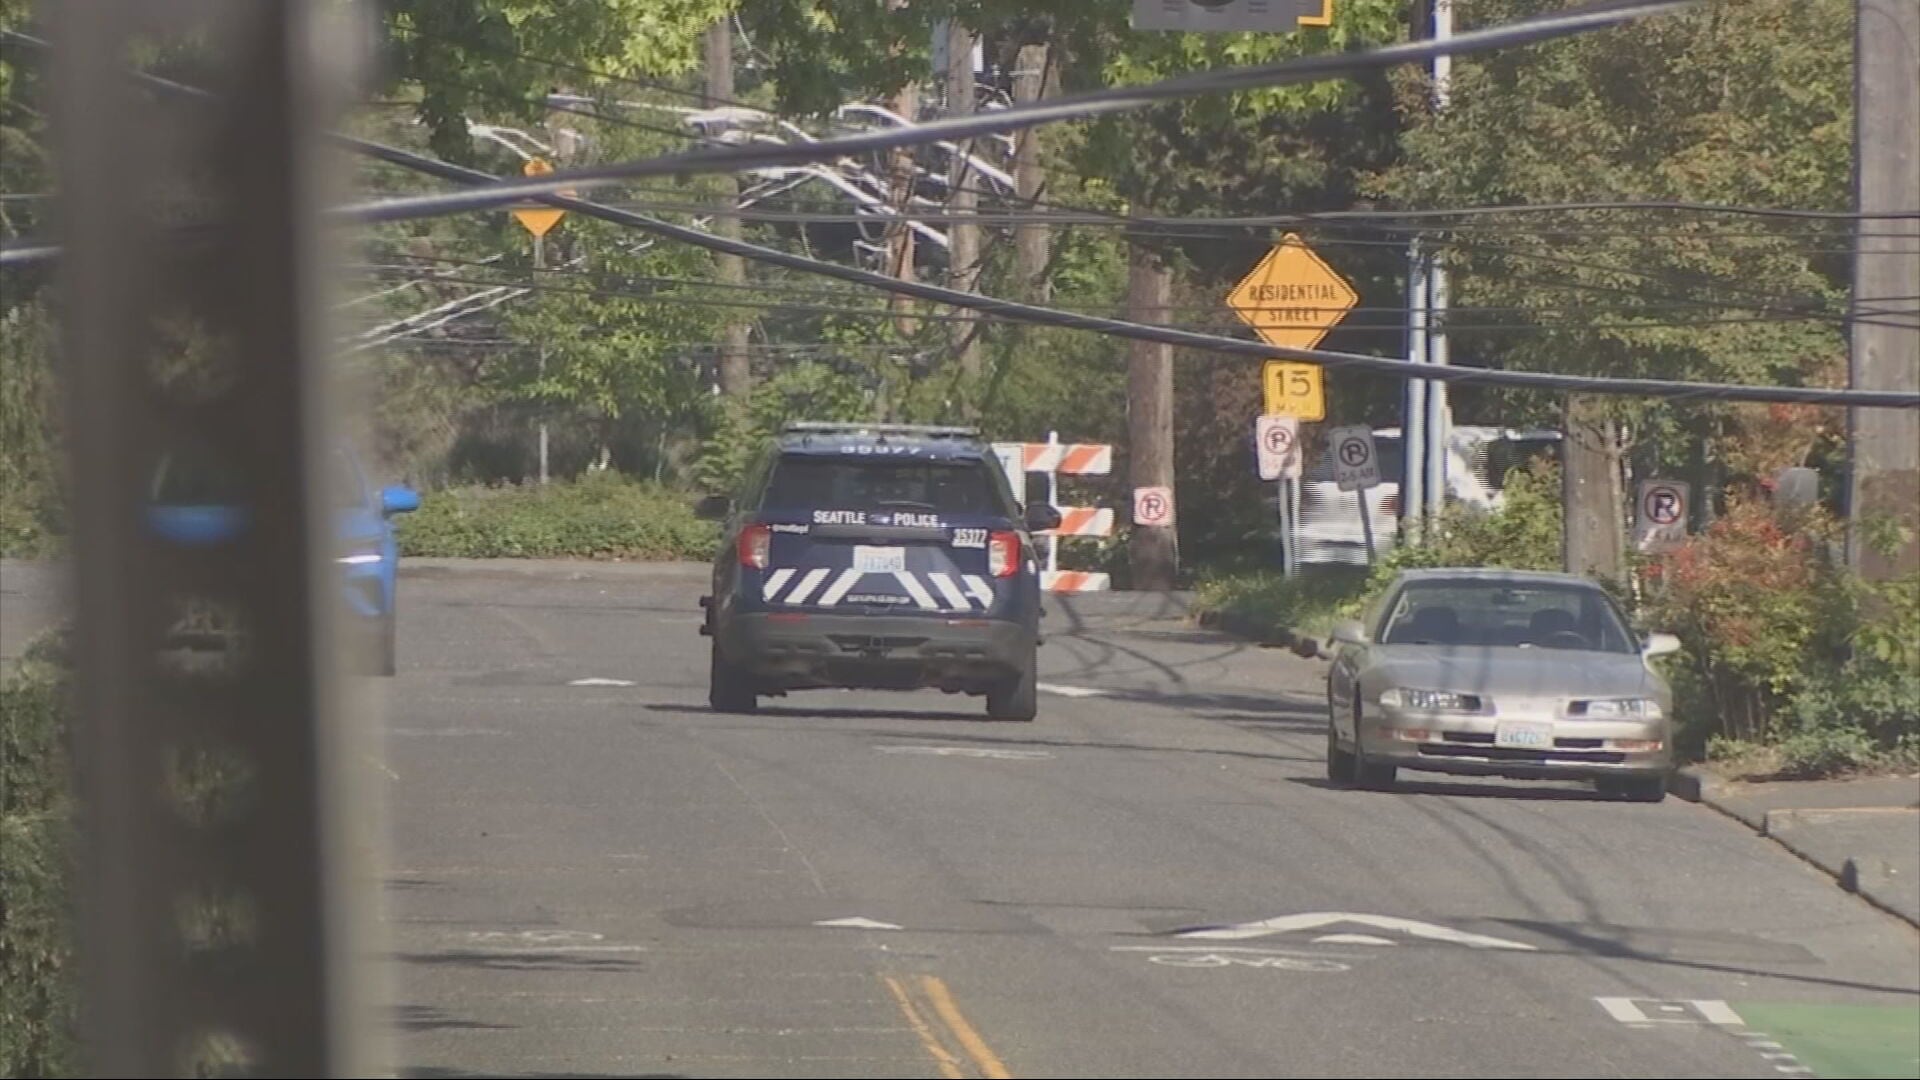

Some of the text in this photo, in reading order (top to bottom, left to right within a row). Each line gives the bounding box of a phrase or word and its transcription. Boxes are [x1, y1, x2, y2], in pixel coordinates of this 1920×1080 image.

[1249, 284, 1338, 301] RESIDENTIAL
[1268, 307, 1319, 322] STREET
[1275, 369, 1311, 398] 15
[813, 510, 939, 527] SEATTLE POLICE
